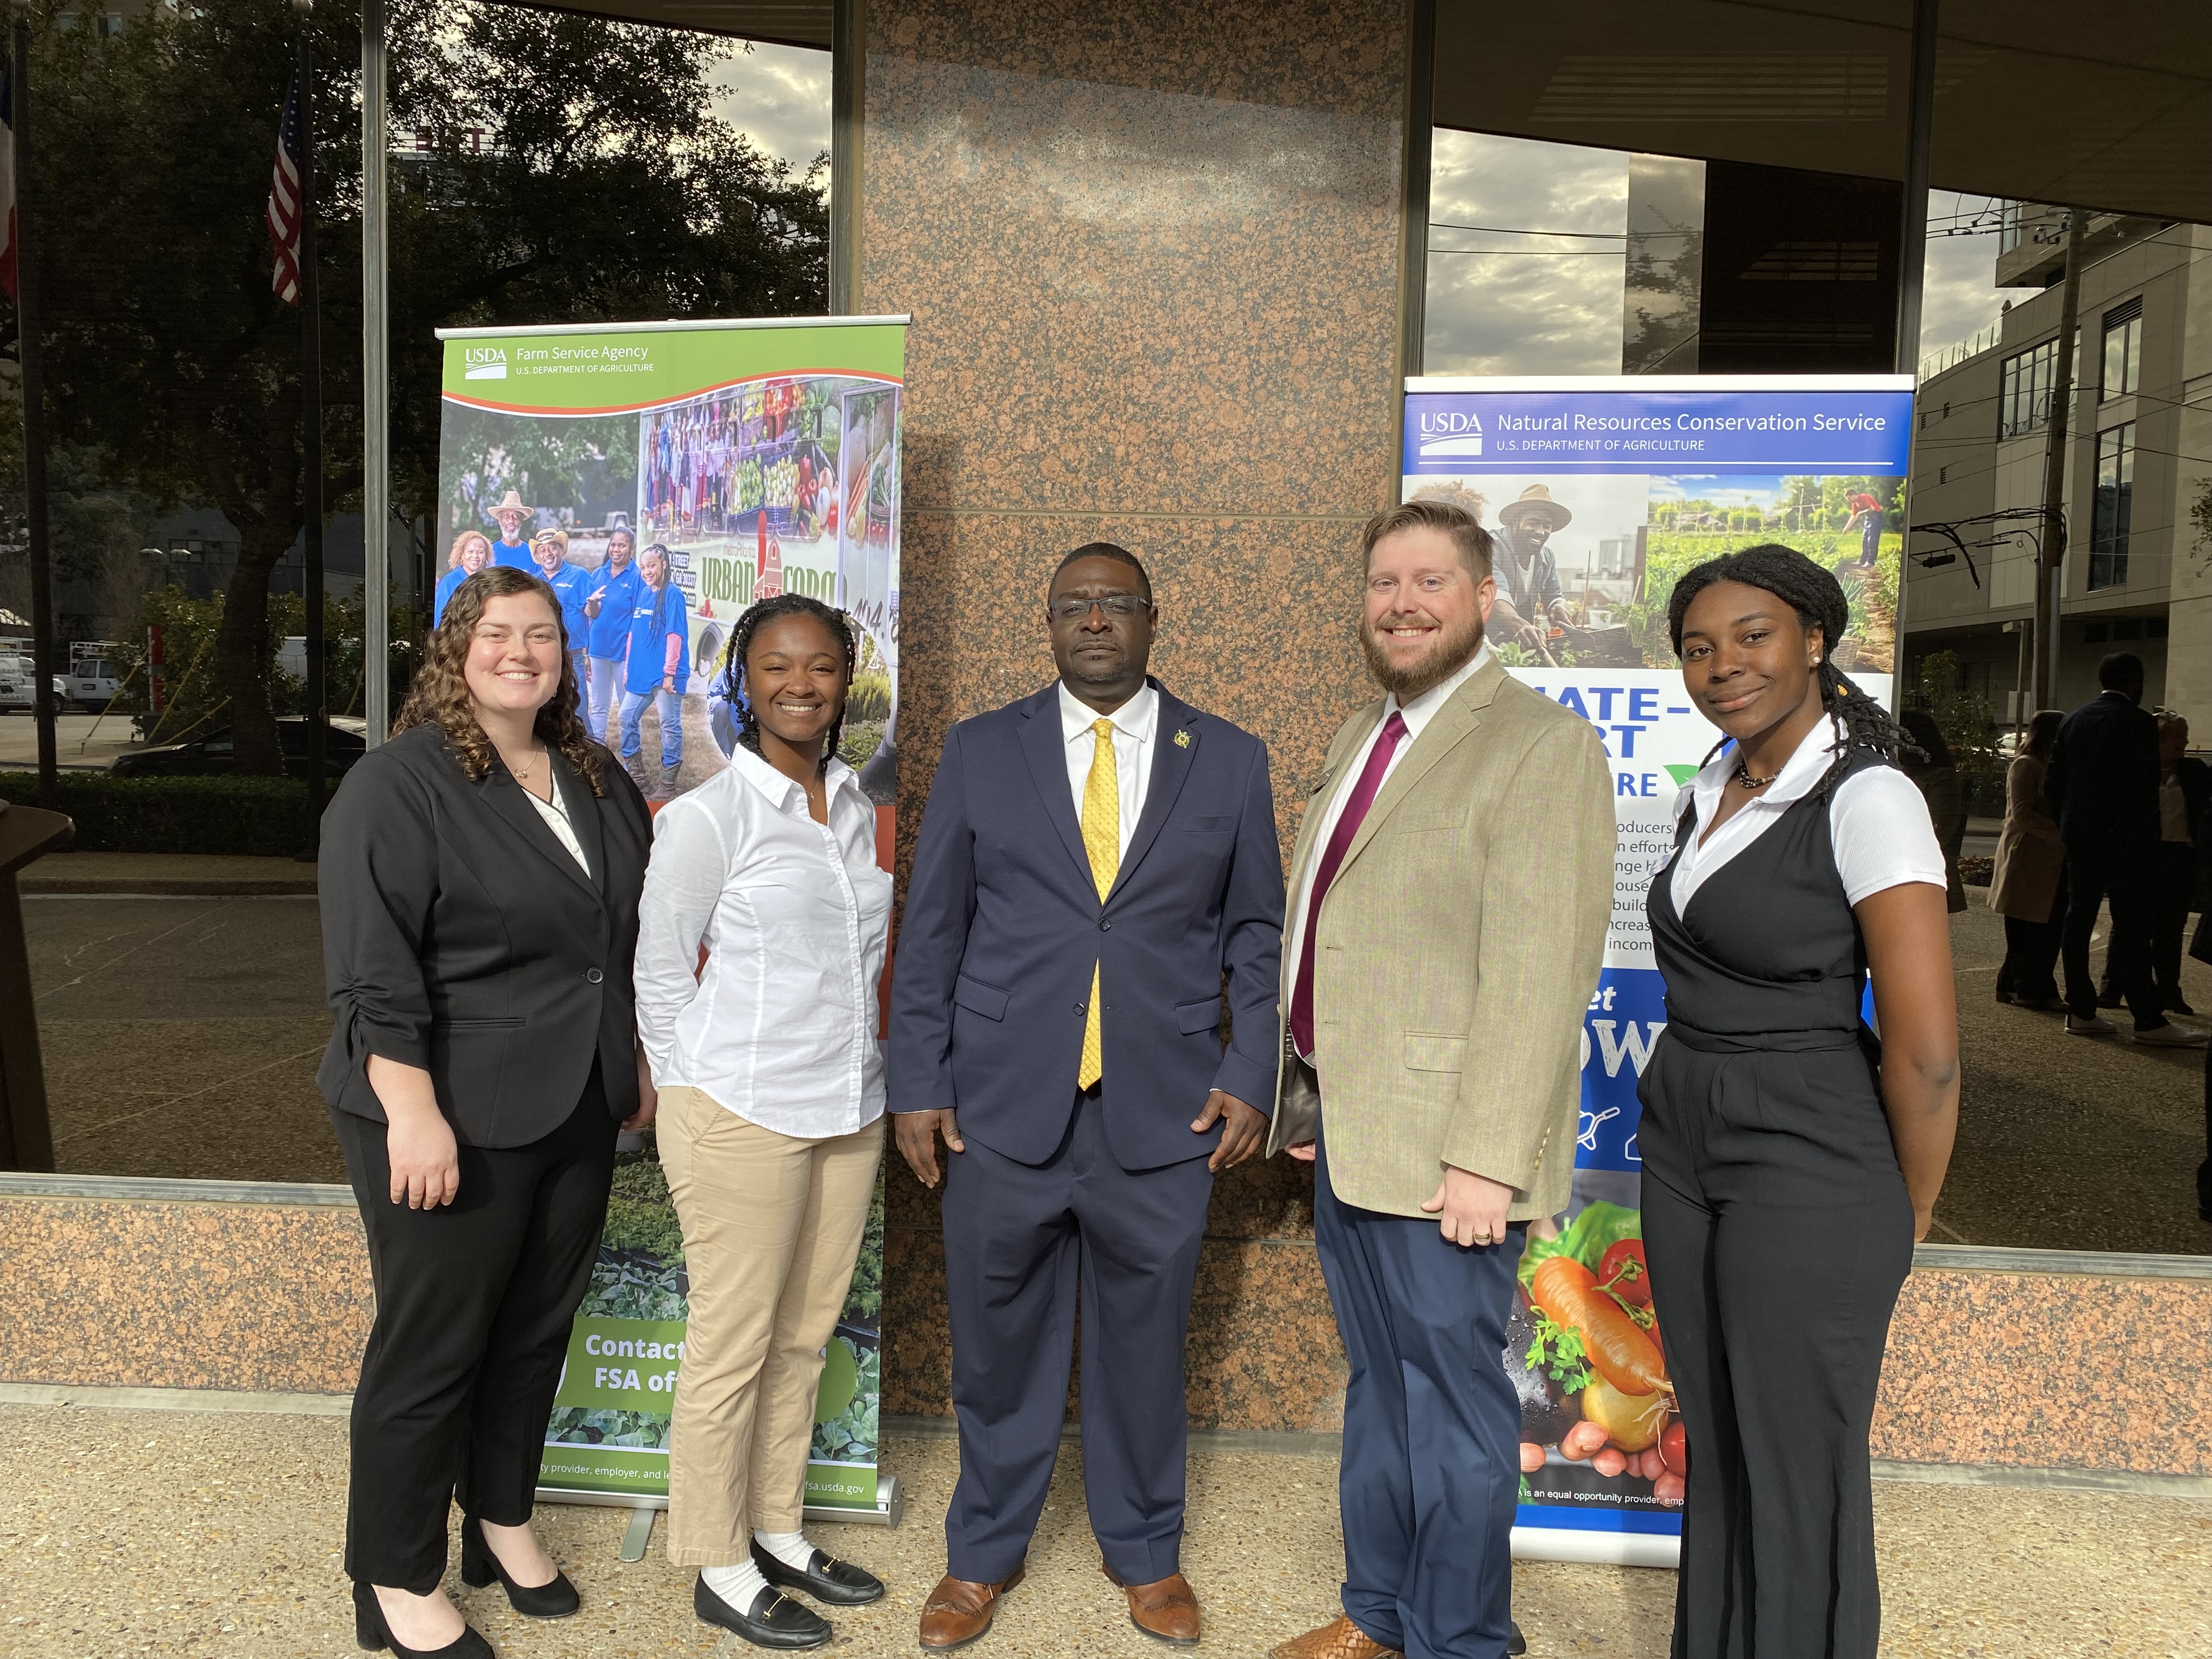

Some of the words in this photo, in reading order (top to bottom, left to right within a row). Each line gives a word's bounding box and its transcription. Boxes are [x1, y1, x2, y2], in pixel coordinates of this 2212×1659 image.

[465, 348, 507, 363] USDA
[517, 348, 548, 360] Farm
[552, 346, 599, 359] Service
[601, 346, 648, 361] Agency
[516, 366, 532, 375] U.S.
[533, 365, 585, 374] DEPARTMENT
[587, 365, 599, 373] OF
[599, 364, 654, 373] AGRICULTURE
[1421, 413, 1483, 432] USDA
[1498, 413, 1567, 431] Natural
[1575, 414, 1672, 431] Resources
[1677, 413, 1807, 431] Conservation
[1813, 413, 1886, 431] Service
[1497, 440, 1519, 450] U.S.
[1522, 440, 1600, 450] DEPARTMENT
[1605, 440, 1620, 450] OF
[1623, 440, 1705, 450] AGRICULTURE
[723, 542, 755, 558] metroAtlanta
[702, 557, 755, 605] URBAN
[1534, 687, 1690, 721] ATE-
[1617, 821, 1672, 833] oducers
[1616, 882, 1649, 892] ouse
[1609, 938, 1652, 950] incom
[585, 1334, 685, 1360] Contact
[595, 1367, 641, 1391] FSA
[648, 1371, 678, 1392] of
[551, 1464, 592, 1475] provider,
[595, 1468, 640, 1479] employer,
[643, 1470, 661, 1479] and
[1524, 1488, 1532, 1497] is
[1547, 1491, 1572, 1500] equal
[1573, 1493, 1622, 1504] opportunity
[1624, 1495, 1662, 1505] provider,
[1665, 1498, 1684, 1506] emp
